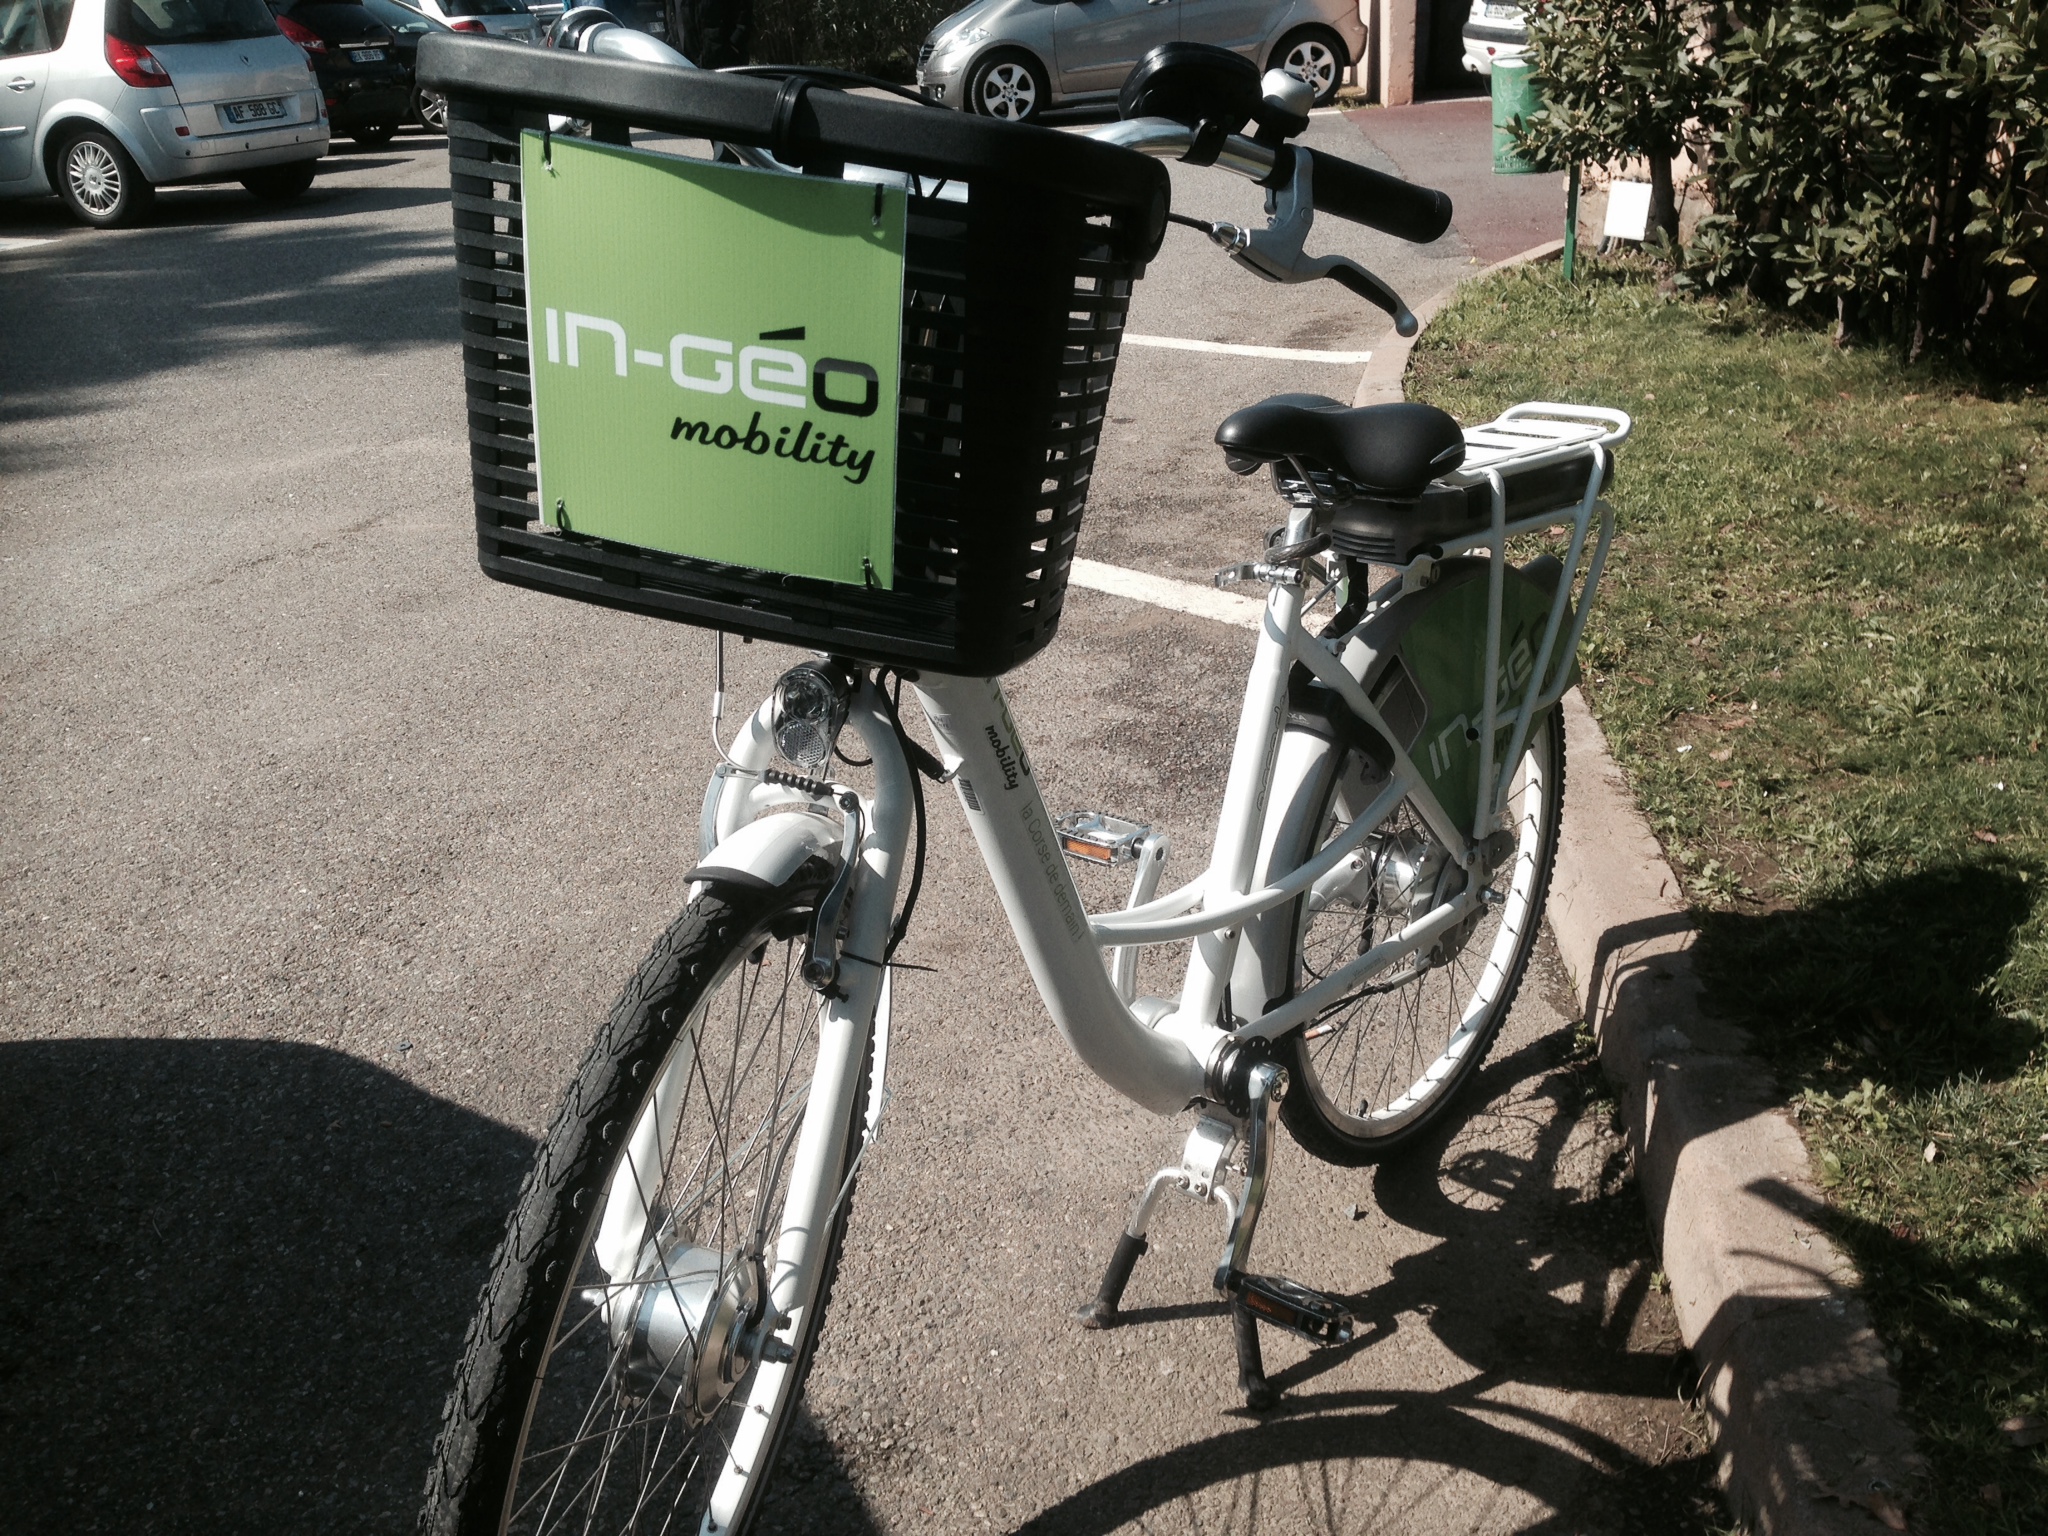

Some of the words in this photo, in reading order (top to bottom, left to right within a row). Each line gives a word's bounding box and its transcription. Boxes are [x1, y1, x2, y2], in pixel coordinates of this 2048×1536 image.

[670, 411, 875, 484] mobility
[985, 724, 1019, 791] mobility
[1021, 800, 1034, 821] la
[1028, 818, 1051, 864] Corse
[1045, 863, 1059, 884] de
